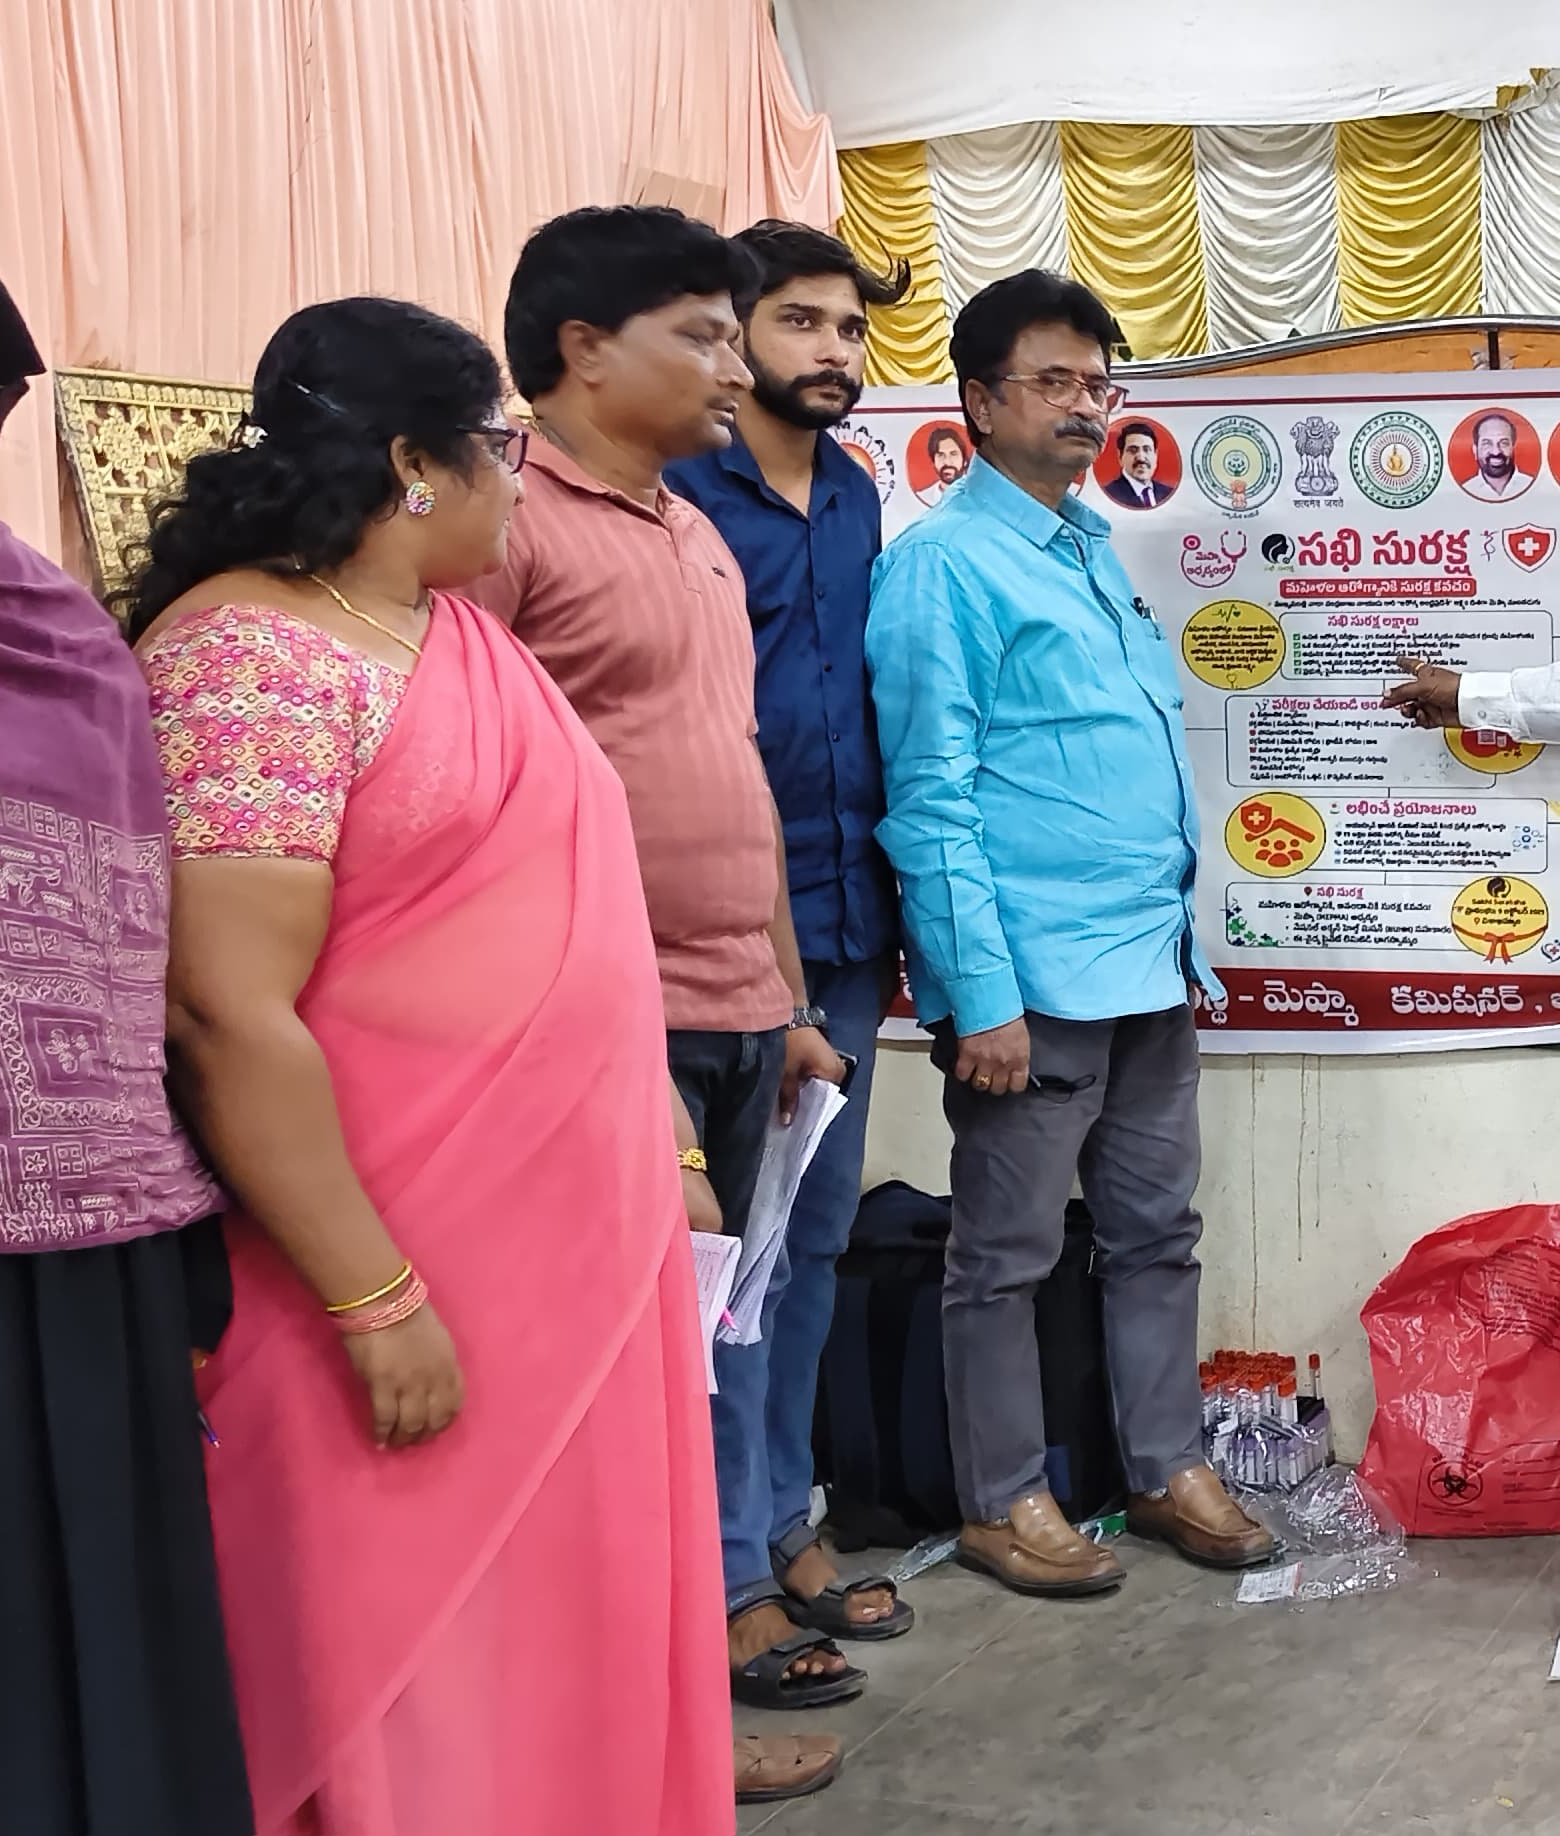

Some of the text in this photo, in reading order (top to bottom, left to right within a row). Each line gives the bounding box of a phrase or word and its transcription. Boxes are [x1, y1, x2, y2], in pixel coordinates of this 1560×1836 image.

[1298, 528, 1471, 577] సఖి సురక్ష
[1400, 580, 1432, 595] సురక్ష
[1433, 580, 1471, 593] కవచం
[1345, 799, 1390, 816] లభించే
[1263, 979, 1360, 1027] మెప్మా
[1391, 985, 1524, 1017] కమిషనర్
